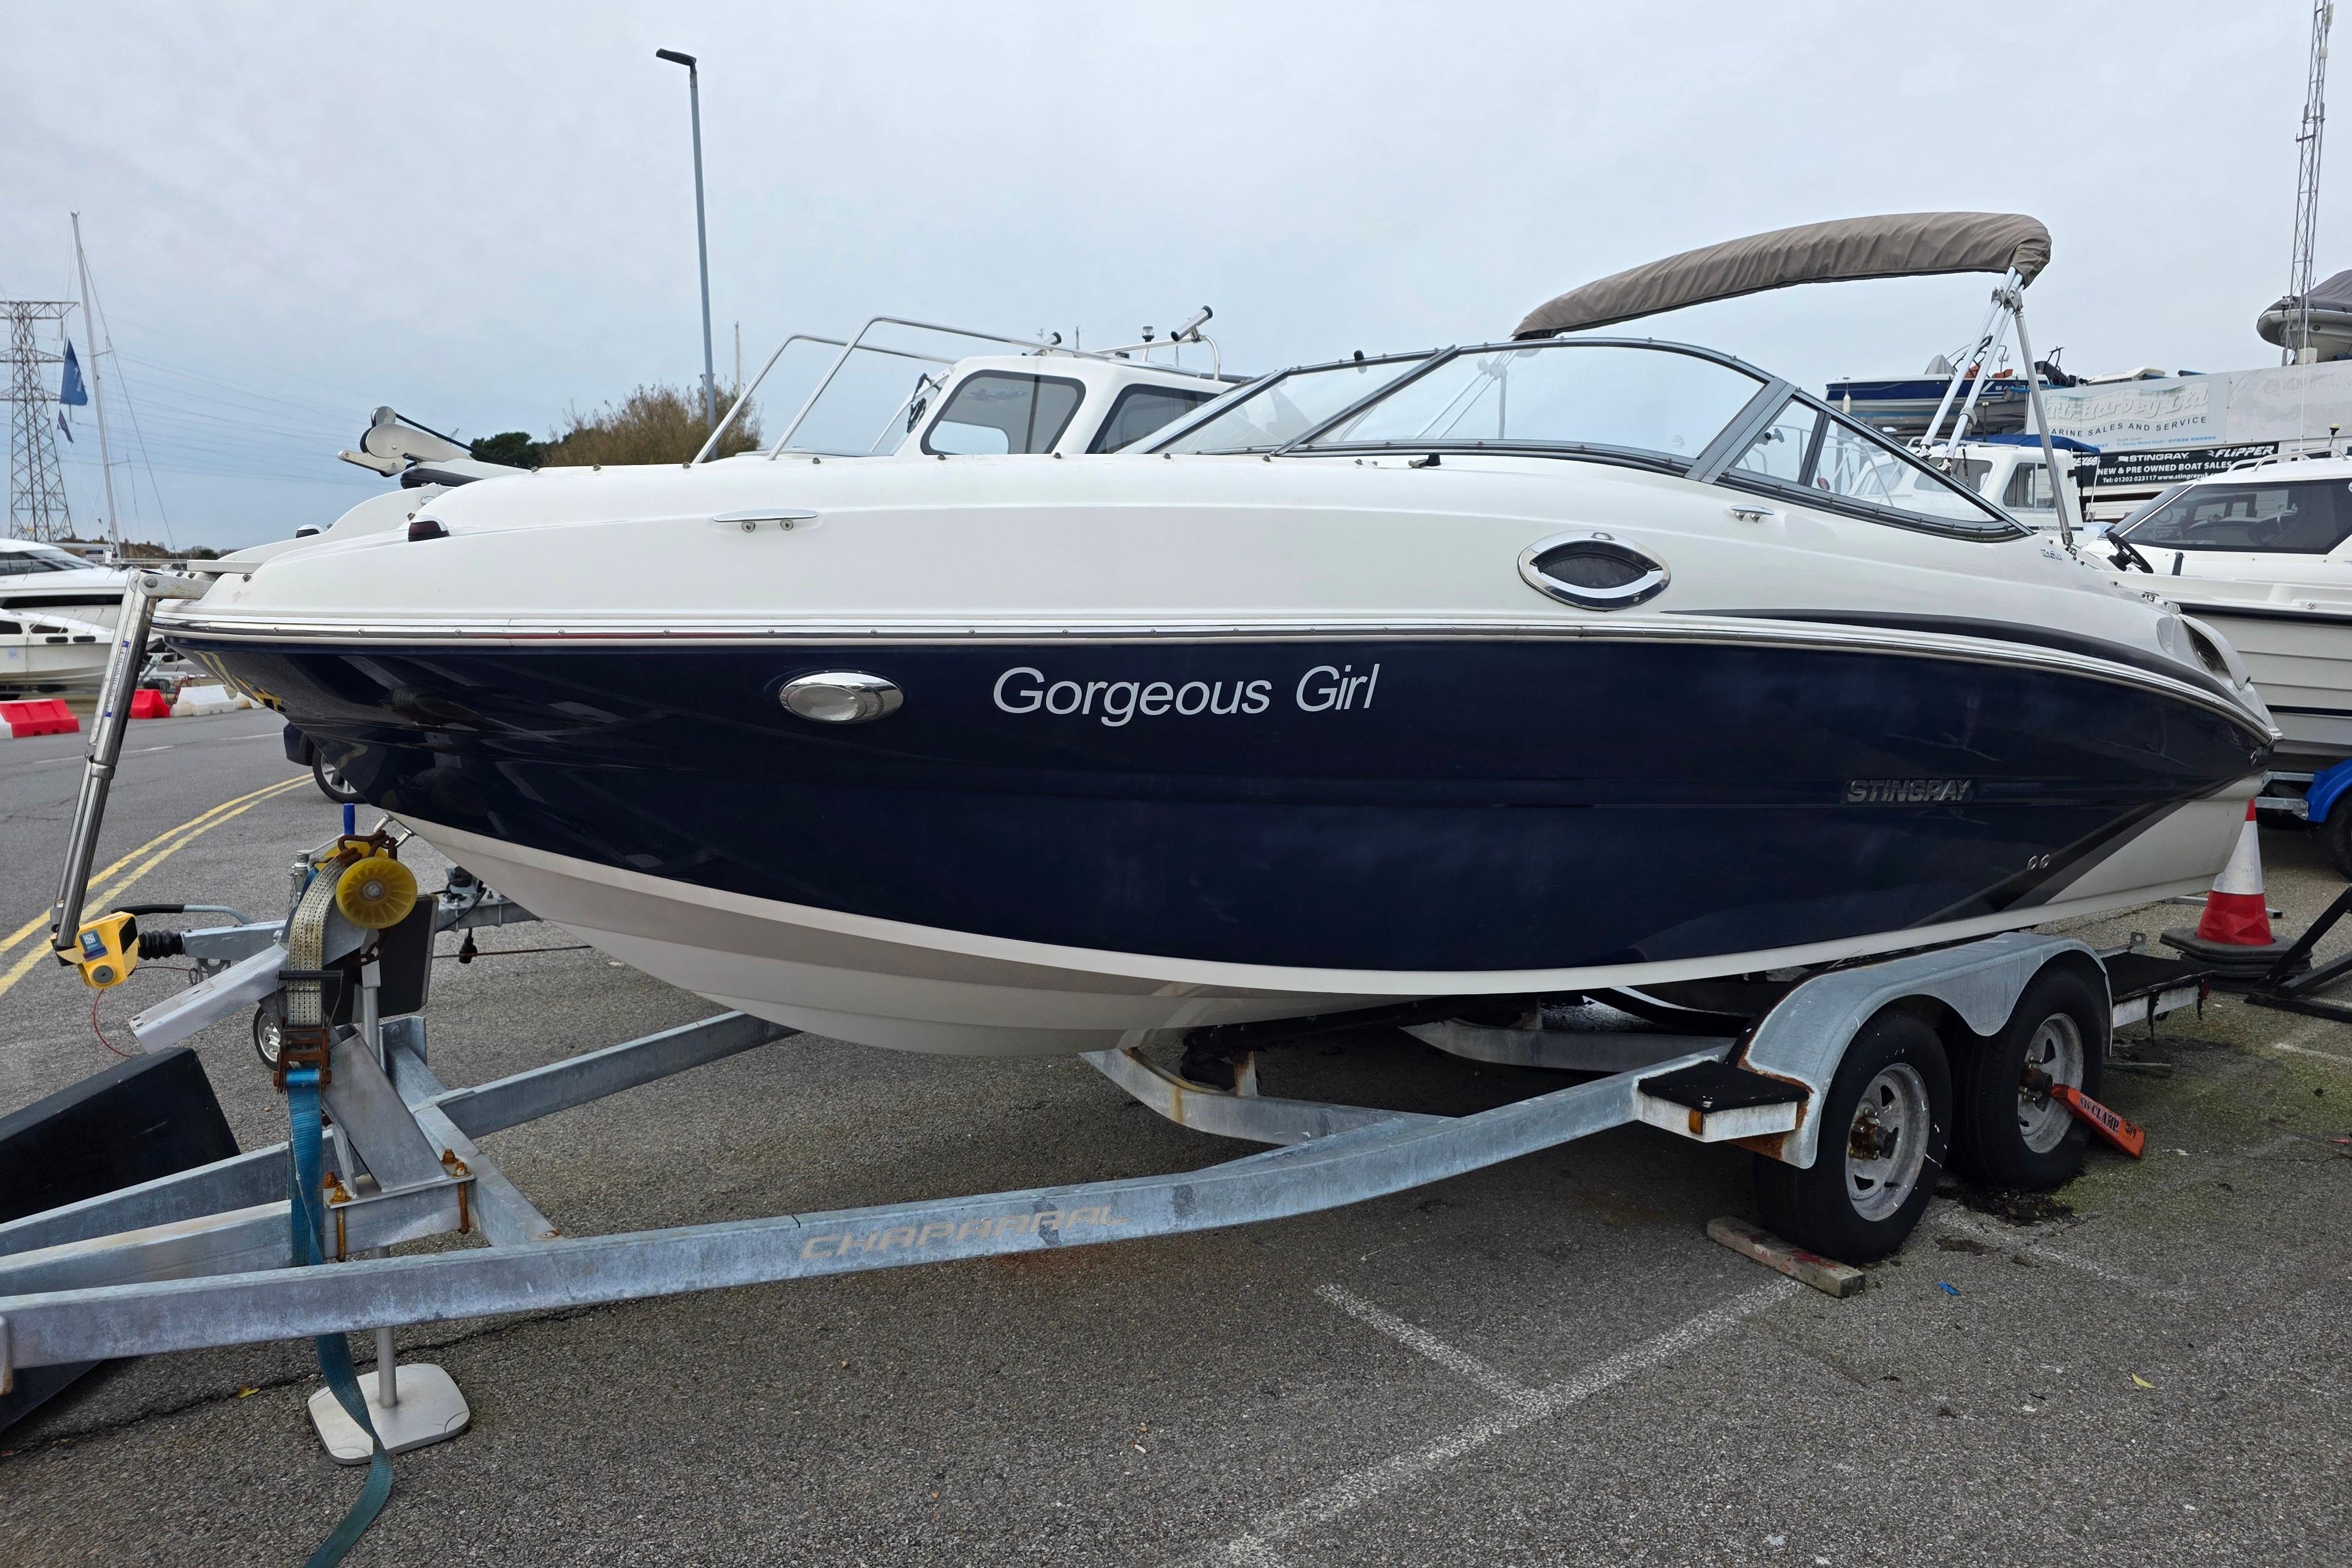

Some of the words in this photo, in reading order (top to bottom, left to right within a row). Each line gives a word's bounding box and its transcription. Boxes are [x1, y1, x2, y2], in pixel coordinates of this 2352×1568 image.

[2048, 428, 2083, 436] ARINE
[2088, 423, 2123, 436] SALES
[2129, 423, 2150, 431] AND
[2156, 416, 2207, 431] SERVICE
[2129, 452, 2189, 462] STINGRAY
[2143, 463, 2177, 473] OWNED
[2179, 462, 2203, 470] BOAT
[2204, 460, 2232, 469] SALES
[993, 666, 1272, 727] Gorgeous
[1295, 663, 1380, 712] Girl
[1847, 779, 1972, 802] STINGRAY
[2079, 1096, 2092, 1111] SAS
[2092, 1104, 2119, 1132] CLAMP
[802, 1204, 1128, 1259] CHAPARRAL
